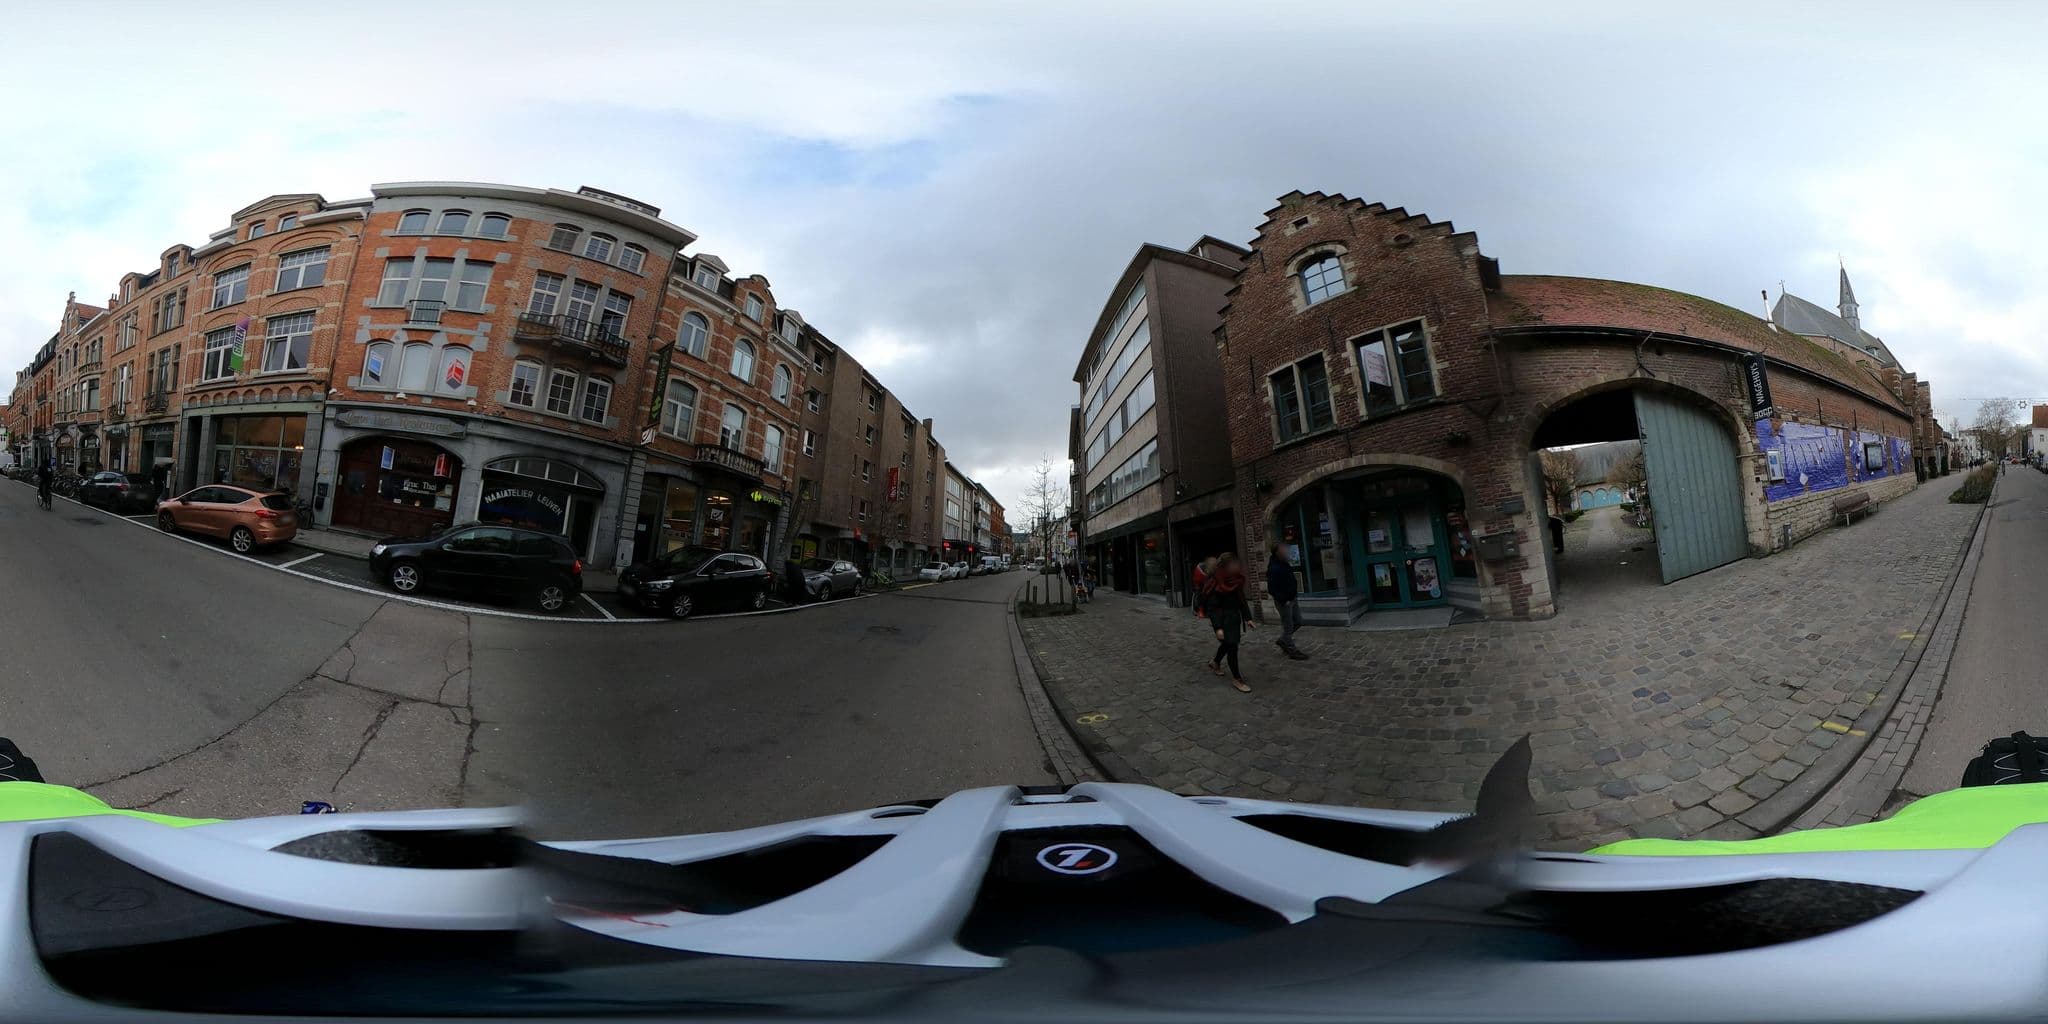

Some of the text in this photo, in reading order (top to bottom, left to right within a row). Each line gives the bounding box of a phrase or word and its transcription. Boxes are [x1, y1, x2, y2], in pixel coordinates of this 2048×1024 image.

[234, 326, 245, 355] GROEN
[1750, 362, 1765, 405] WAGEHUYS
[484, 488, 563, 515] NAAIATELIER LEUVEN
